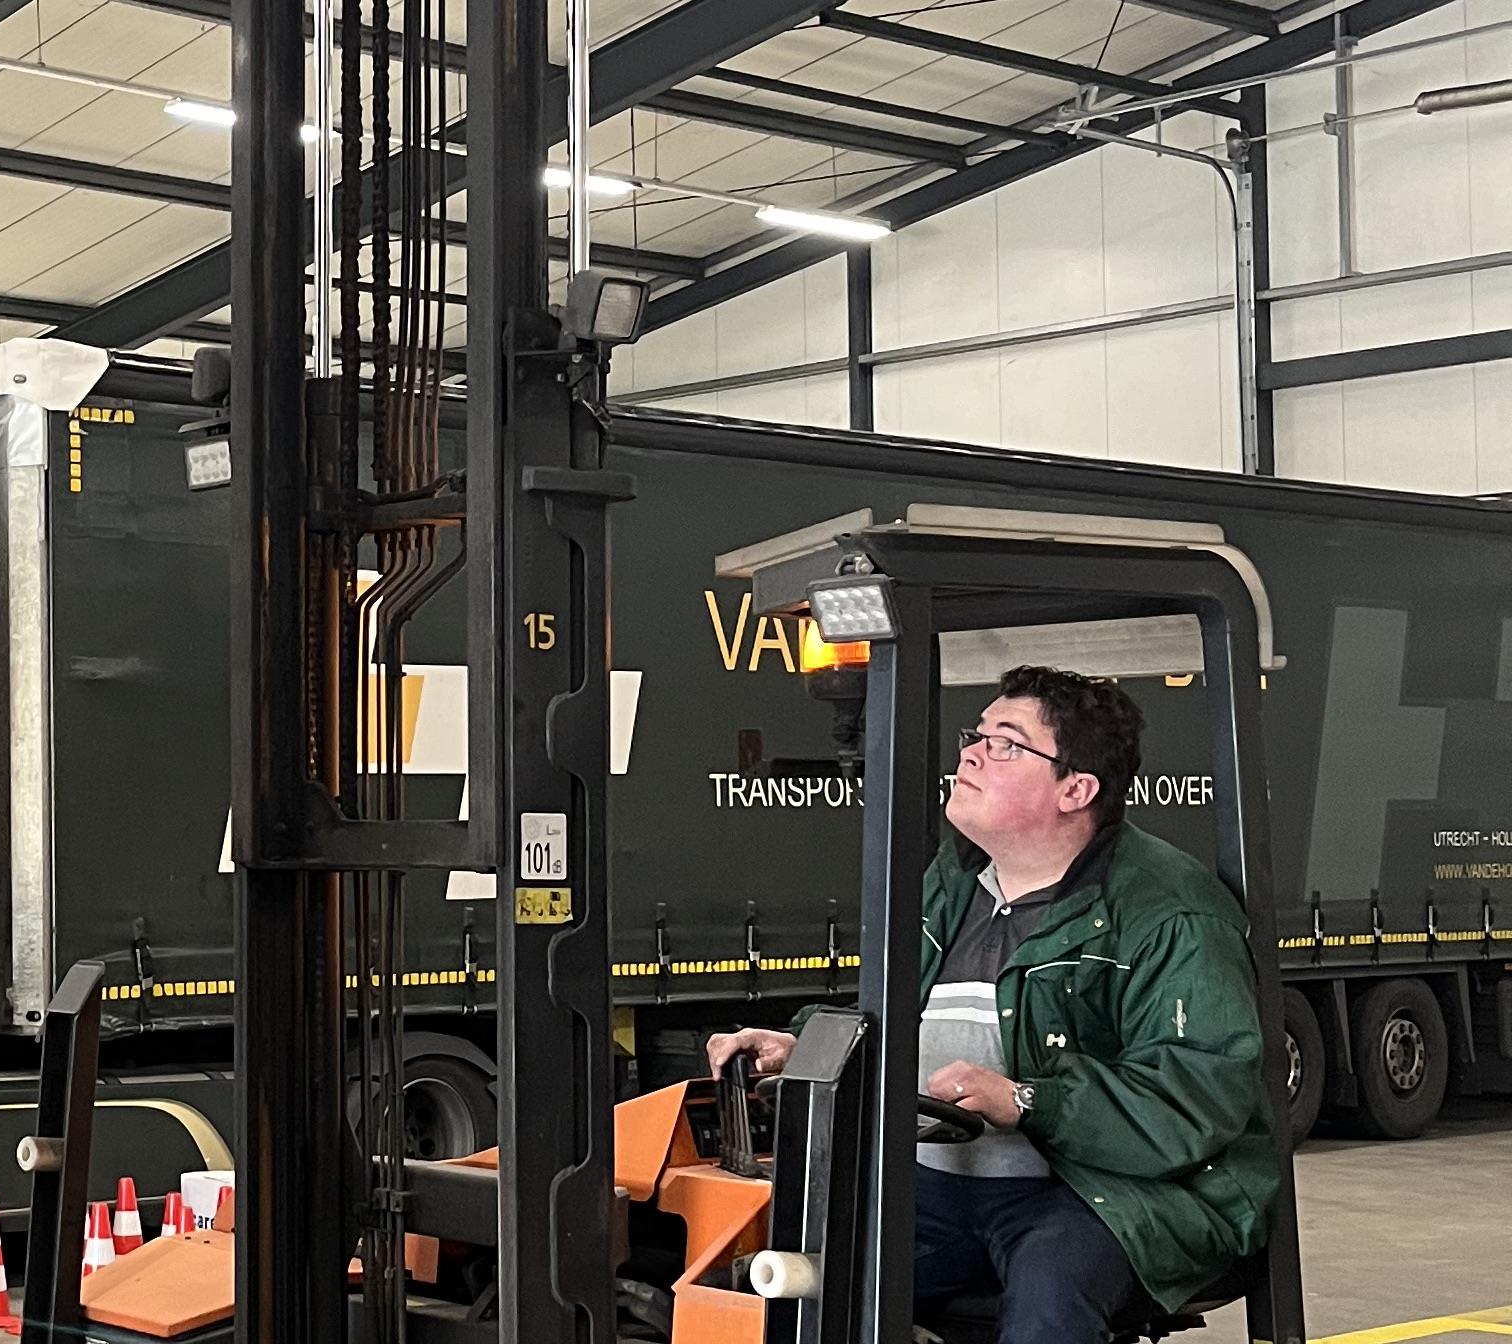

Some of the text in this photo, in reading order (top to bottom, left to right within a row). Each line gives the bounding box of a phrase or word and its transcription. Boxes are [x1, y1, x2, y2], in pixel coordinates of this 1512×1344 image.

[524, 613, 555, 650] 15
[704, 590, 806, 673] VA
[1433, 830, 1480, 847] UTRECHT
[525, 842, 551, 874] 101
